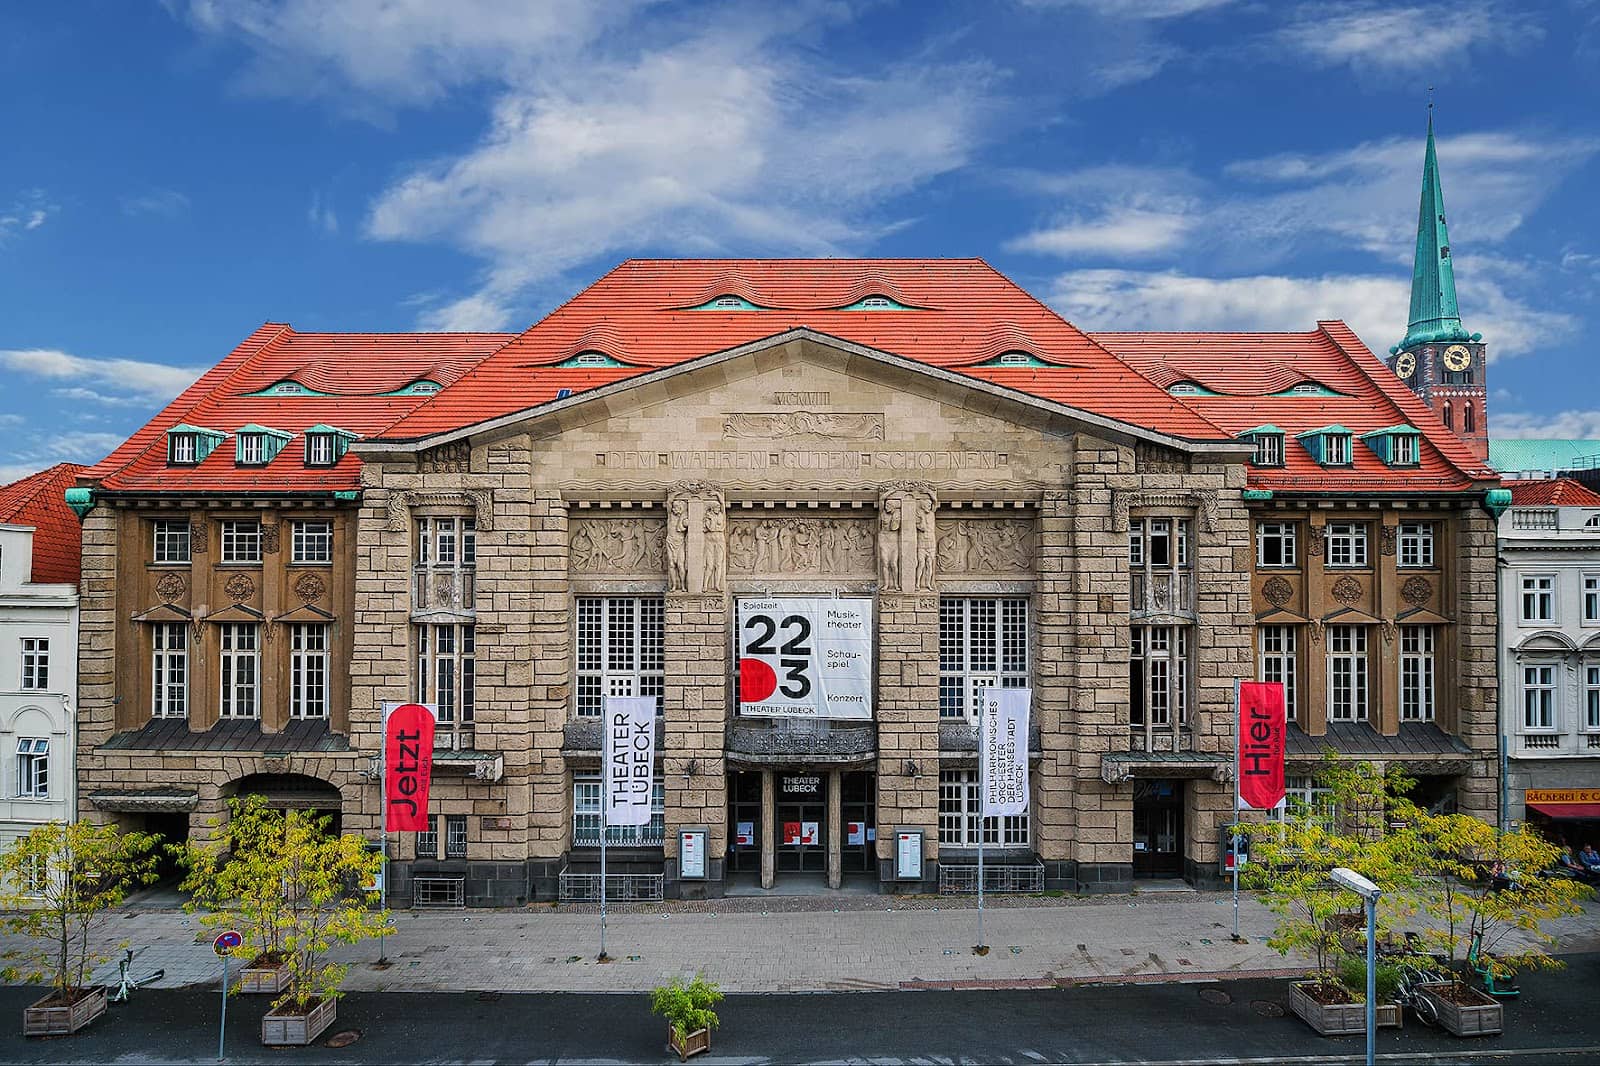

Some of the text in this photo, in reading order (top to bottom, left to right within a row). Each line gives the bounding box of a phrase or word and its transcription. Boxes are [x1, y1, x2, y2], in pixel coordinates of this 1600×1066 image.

[607, 450, 998, 470] DEM WAHREN GUTEN SCHOENEN
[743, 602, 778, 610] Spielzeit
[827, 610, 860, 619] Musik-
[745, 614, 812, 655] 22
[827, 620, 862, 629] theater
[827, 649, 862, 659] Schau-
[827, 659, 850, 669] spiel
[827, 693, 864, 703] Konzert
[745, 705, 781, 713] THEATER
[1244, 706, 1271, 776] Hier
[612, 713, 630, 809] THEATER
[989, 700, 998, 804] PHILHARMONISCHES
[1007, 717, 1017, 803] DER HANSESTADT
[391, 729, 421, 817] Jetzt
[632, 720, 650, 806] LÜBECK
[783, 776, 820, 784] THEATER
[998, 743, 1007, 804] ORCHESTER
[1016, 764, 1025, 803] LÜBECK
[1526, 792, 1575, 801] BÄCKEREI
[1580, 793, 1589, 801] &
